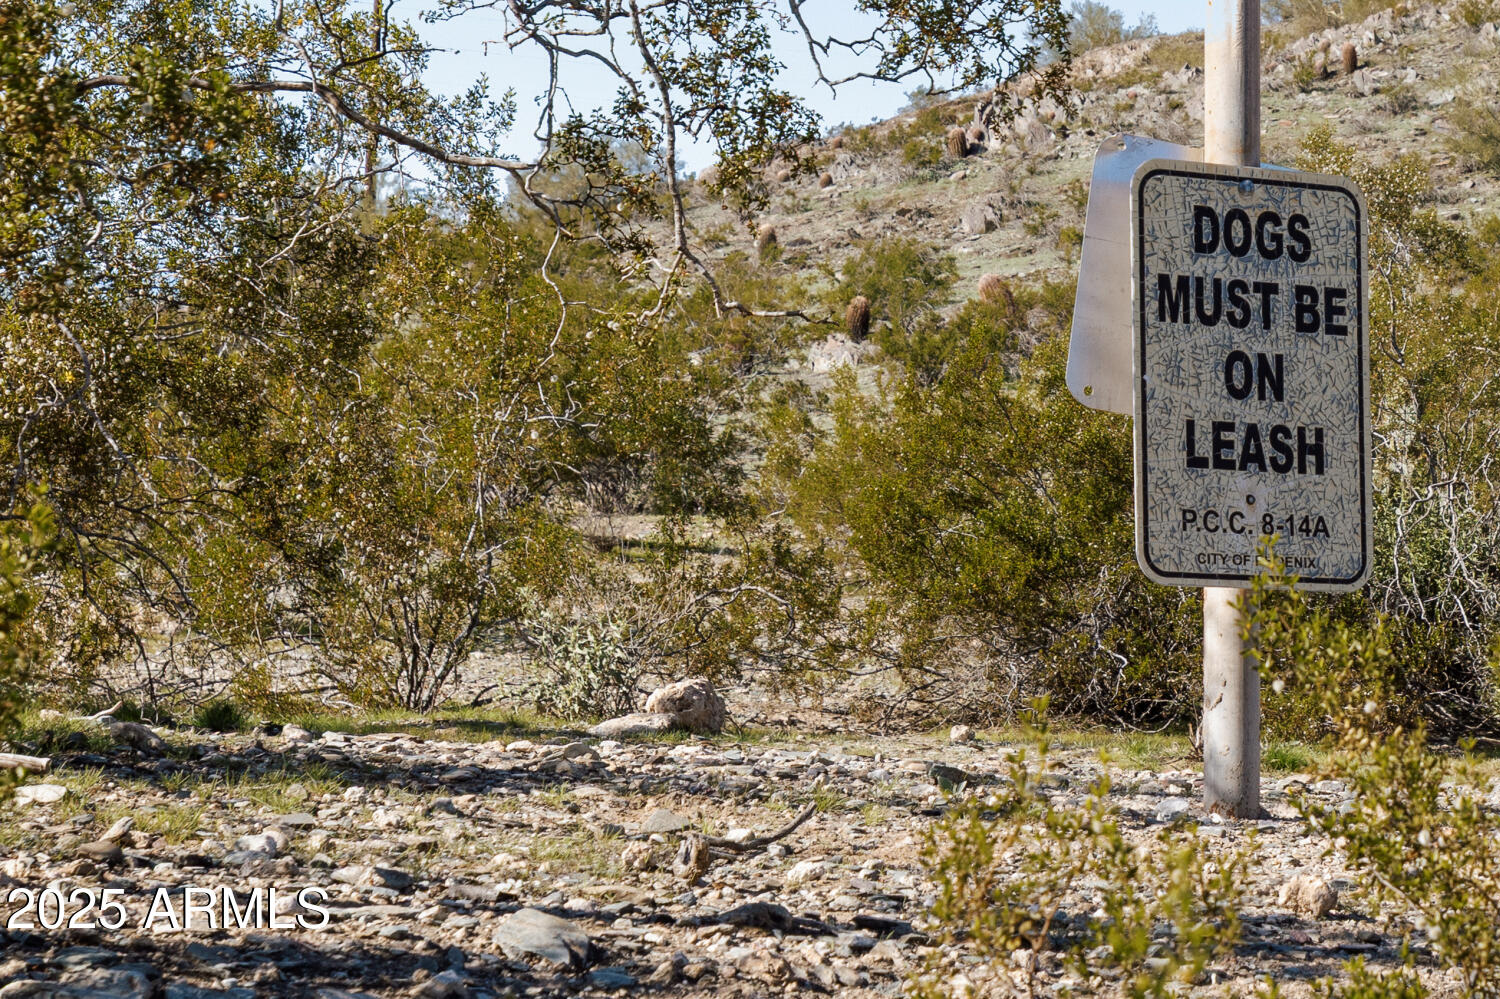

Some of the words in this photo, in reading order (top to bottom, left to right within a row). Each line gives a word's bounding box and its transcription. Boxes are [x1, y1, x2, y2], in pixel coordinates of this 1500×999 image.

[1193, 204, 1311, 262] DOGS
[1157, 273, 1279, 330] MUST
[1295, 284, 1348, 336] BE
[1224, 350, 1284, 401] ON
[1186, 419, 1325, 475] LEASH
[1182, 509, 1253, 535] P.C.C.
[1261, 512, 1331, 538] 8-14A
[1198, 552, 1229, 565] CITY
[1232, 554, 1251, 566] OF
[1255, 555, 1317, 569] PENIX
